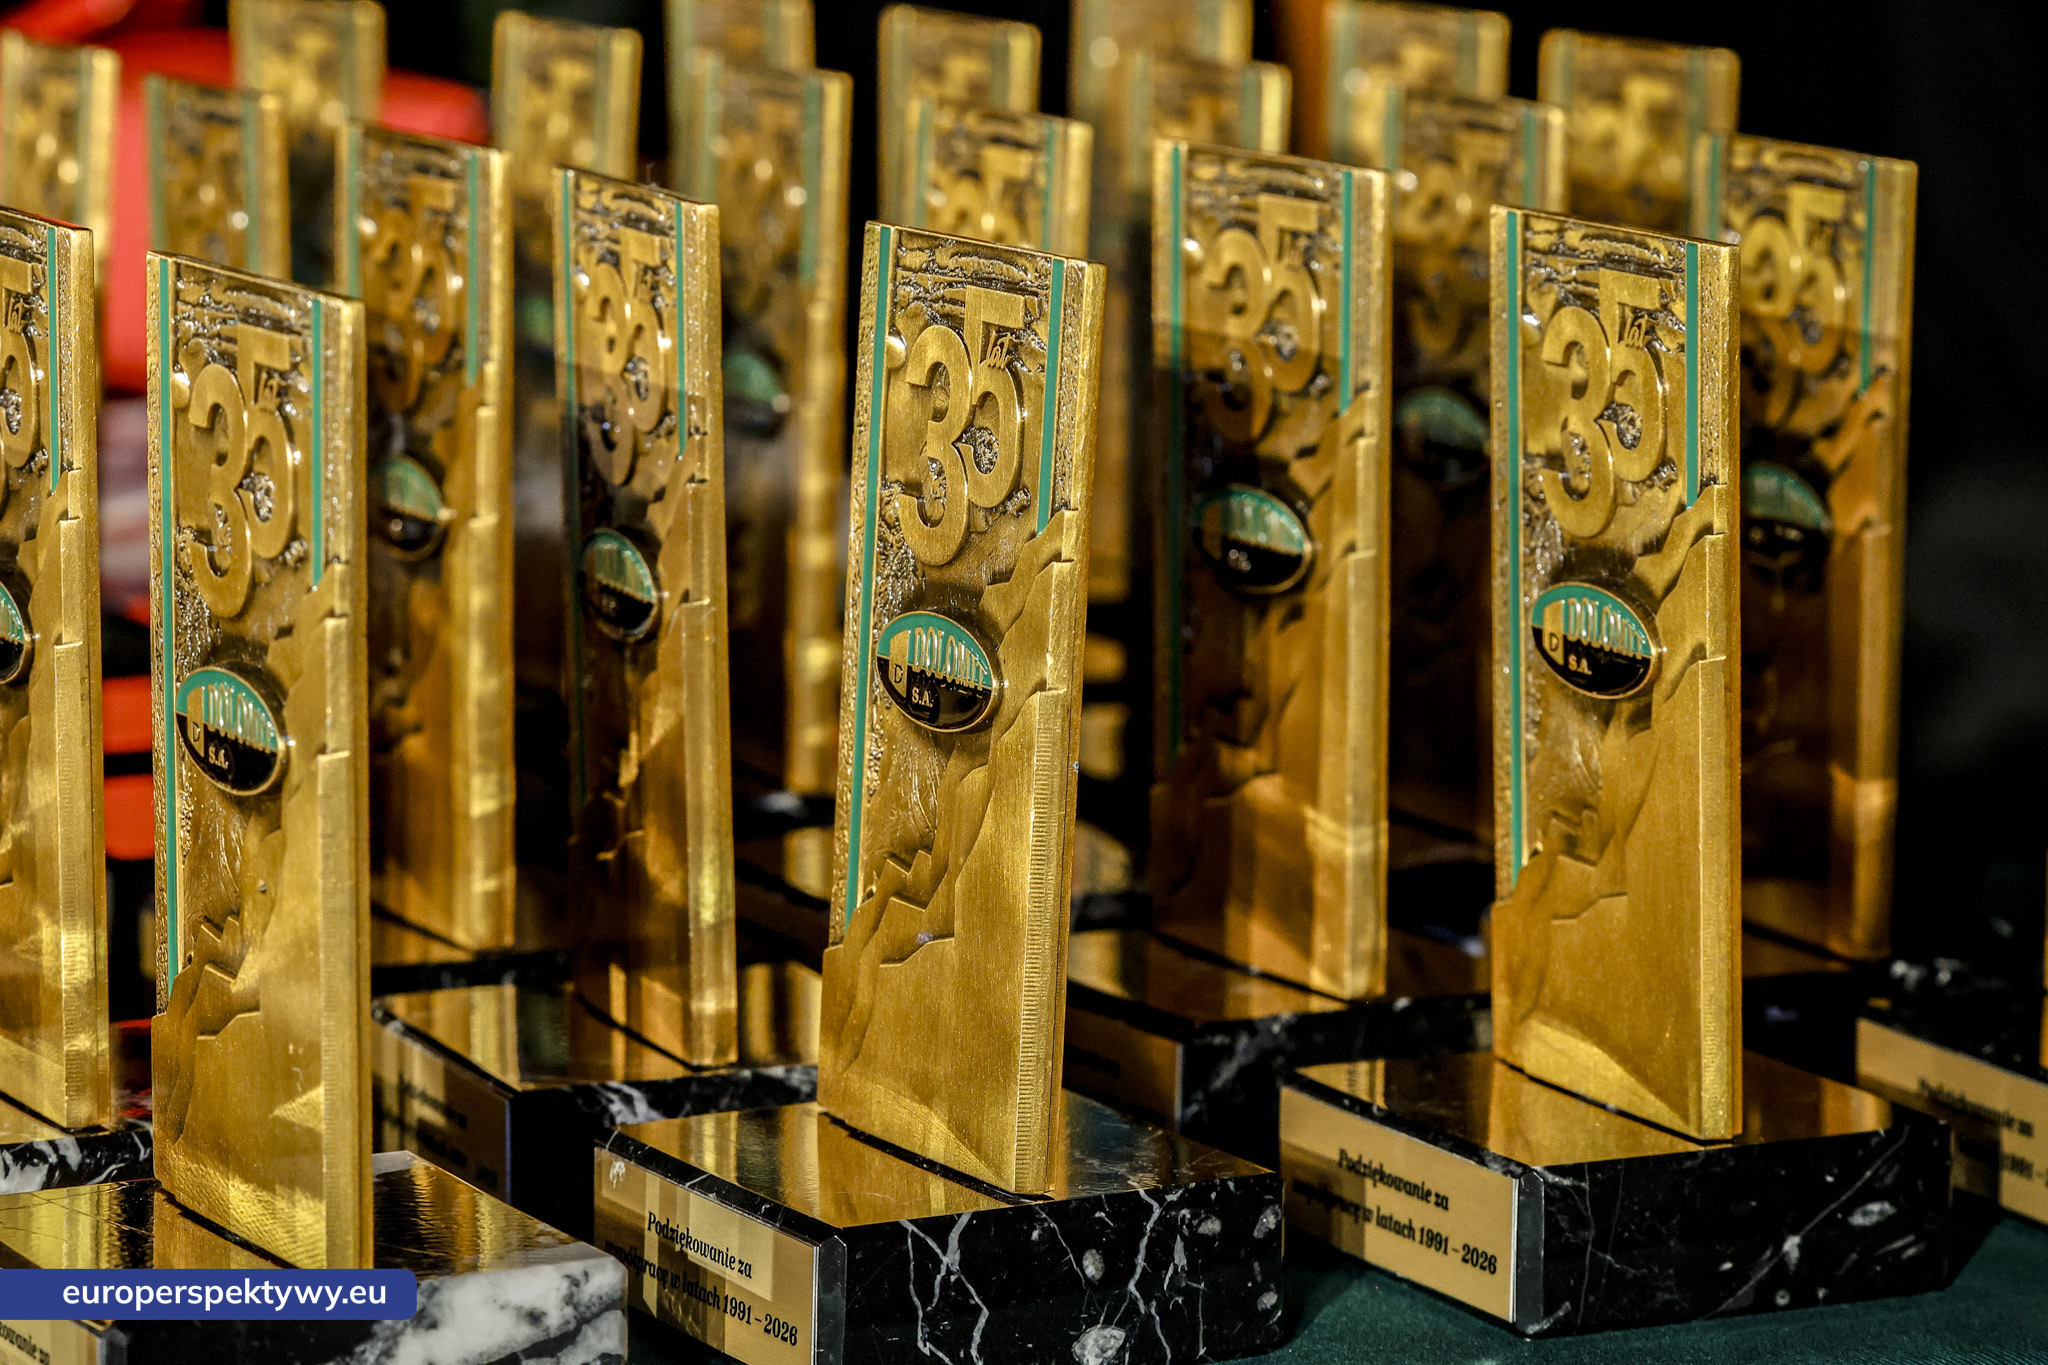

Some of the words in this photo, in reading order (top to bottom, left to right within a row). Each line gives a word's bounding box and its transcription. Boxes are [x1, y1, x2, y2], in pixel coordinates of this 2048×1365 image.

[898, 285, 1023, 566] 35
[1540, 267, 1665, 538] 35
[187, 321, 293, 618] 35
[1338, 1147, 1433, 1205] Podziękowanie
[1434, 1190, 1450, 1212] za
[647, 1211, 737, 1271] Podziękowanie
[738, 1259, 753, 1279] za
[1376, 1205, 1416, 1242] latach
[1419, 1226, 1450, 1256] 1991
[1461, 1243, 1498, 1276] 2026
[683, 1271, 721, 1311] latach
[724, 1294, 752, 1326] 1991
[764, 1313, 798, 1347] 2026
